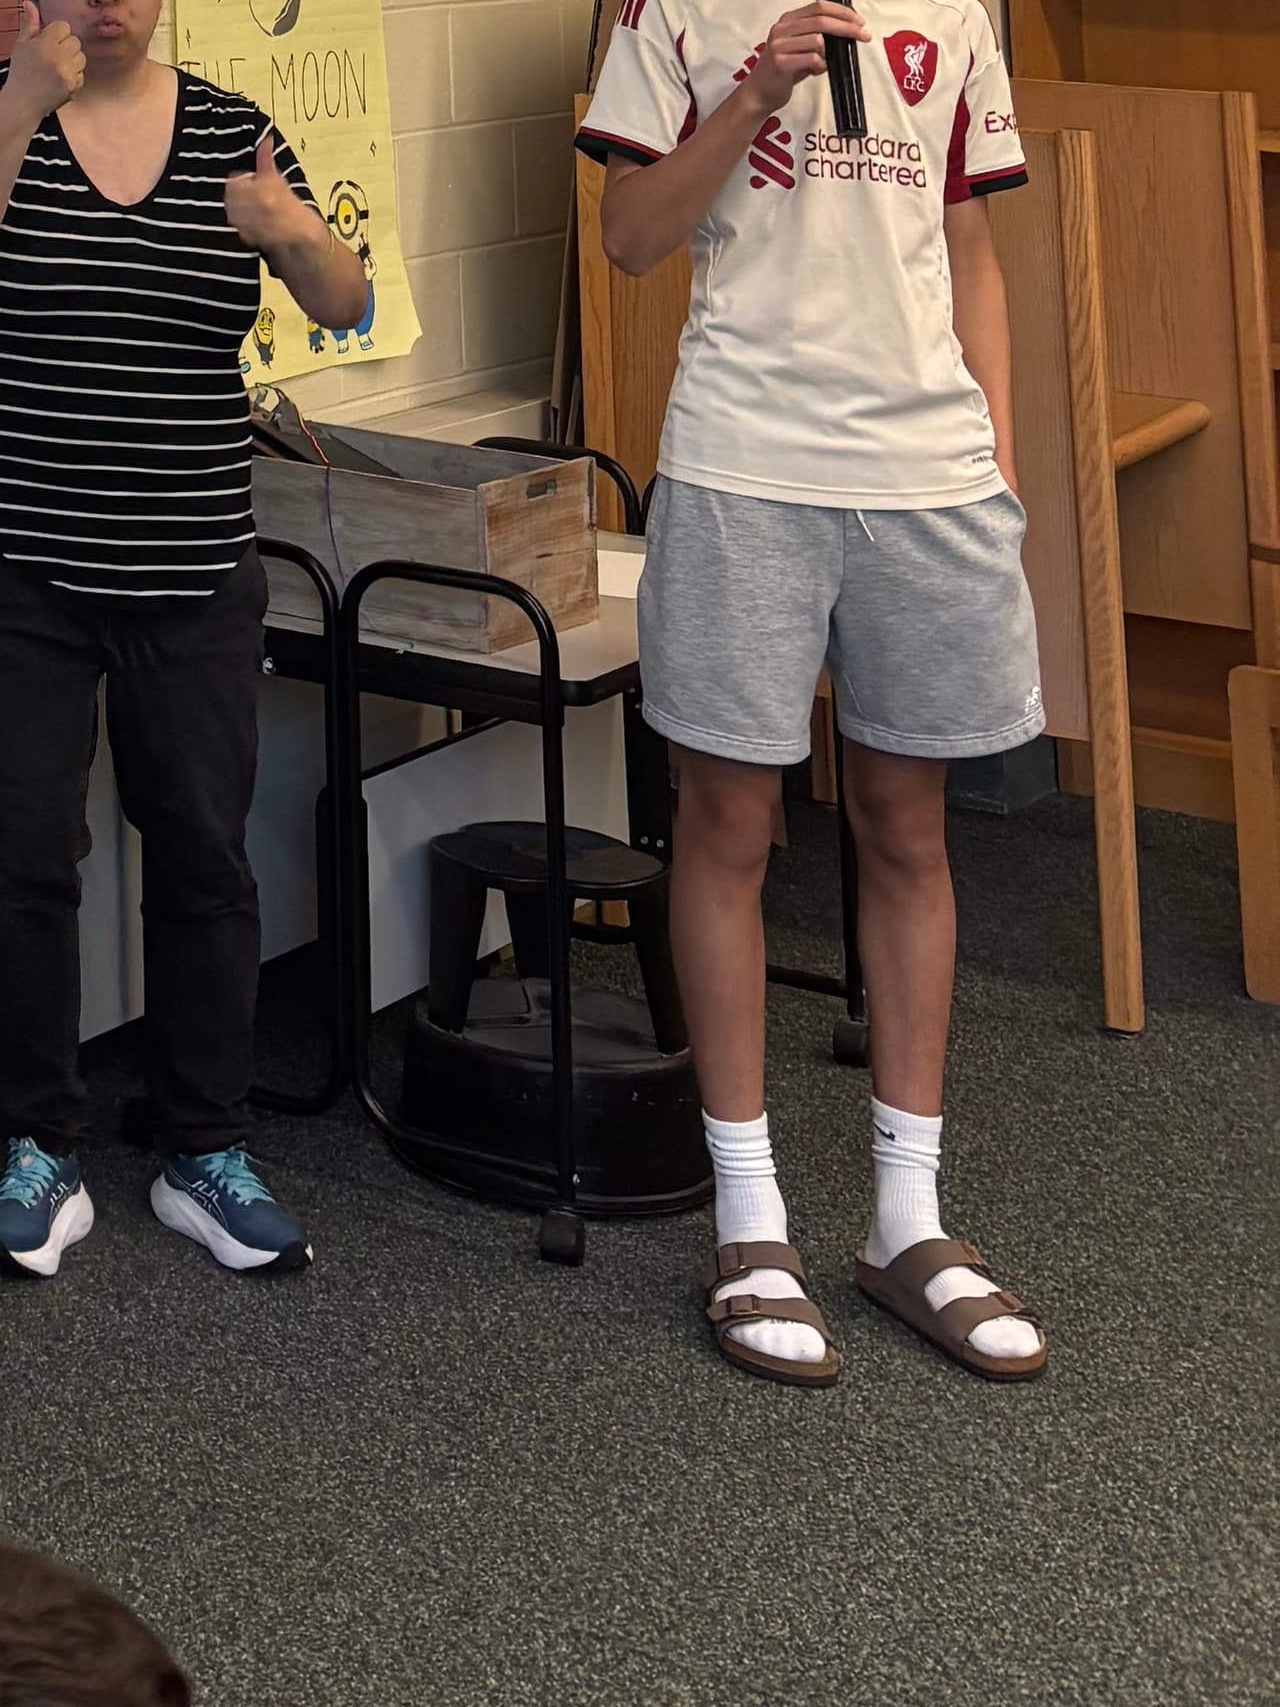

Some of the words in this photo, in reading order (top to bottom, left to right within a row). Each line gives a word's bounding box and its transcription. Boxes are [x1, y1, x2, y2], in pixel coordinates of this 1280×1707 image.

[271, 48, 368, 124] MOON
[804, 128, 921, 163] standard
[804, 154, 927, 189] chartered
